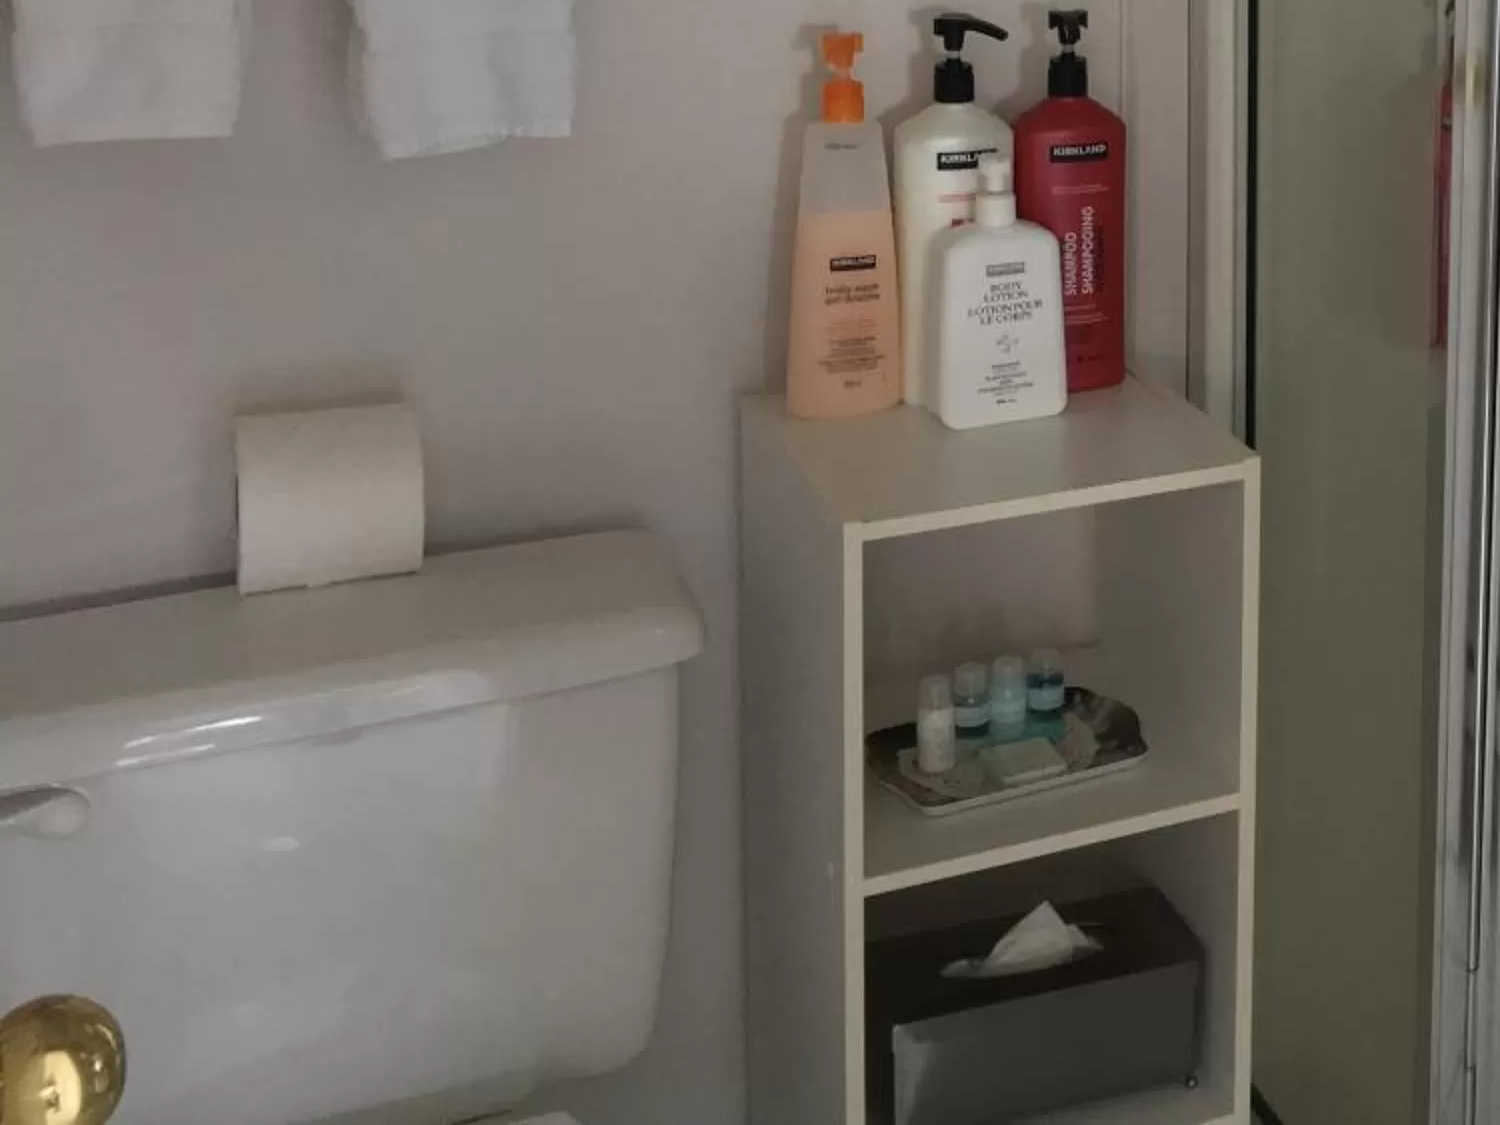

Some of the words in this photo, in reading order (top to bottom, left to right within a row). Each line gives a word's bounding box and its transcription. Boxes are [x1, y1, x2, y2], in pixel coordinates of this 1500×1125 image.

[940, 153, 977, 164] KIRKL
[1053, 144, 1107, 157] KIRKLAND
[1063, 231, 1078, 297] SHAMPOO
[1080, 205, 1095, 295] SHAMPOOING
